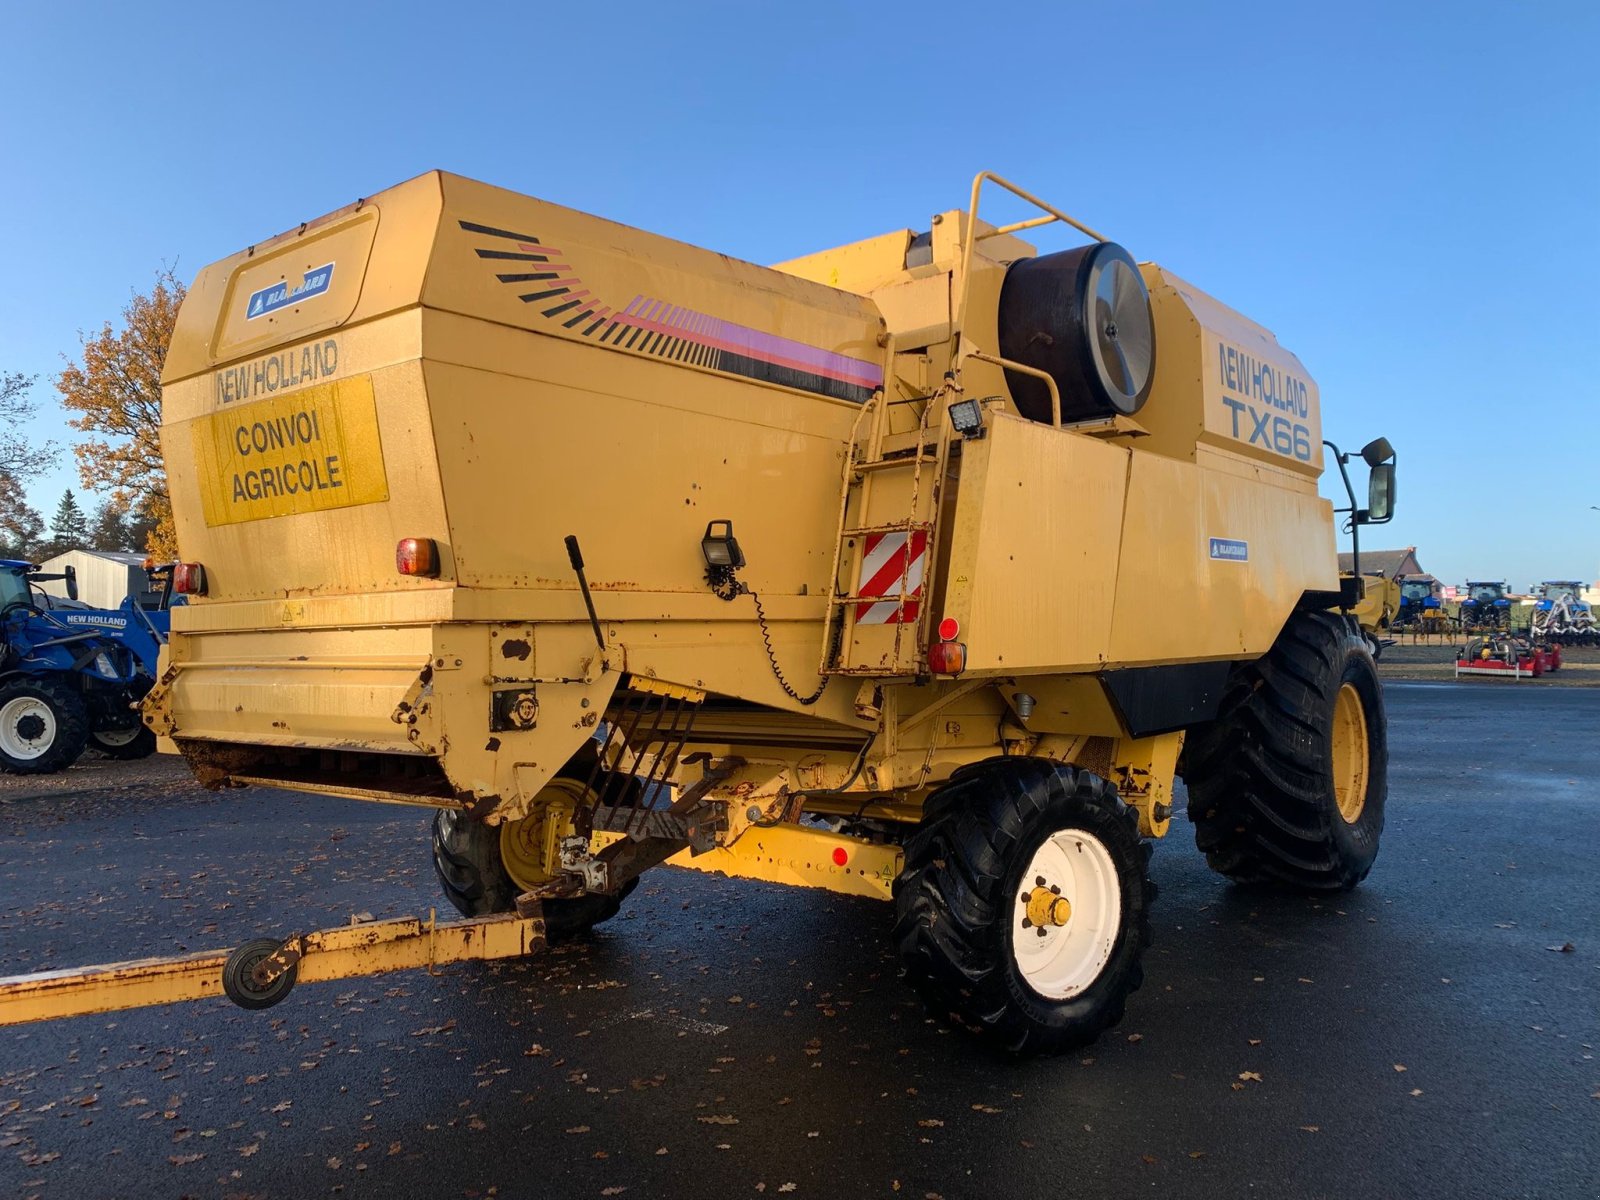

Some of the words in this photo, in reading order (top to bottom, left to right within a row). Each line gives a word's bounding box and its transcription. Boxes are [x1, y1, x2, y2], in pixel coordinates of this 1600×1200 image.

[216, 364, 251, 405] NEW
[254, 339, 338, 396] HOLLAND
[1219, 342, 1250, 396] NEW
[1252, 358, 1308, 419] HOLLAND
[236, 410, 320, 456] CONVOI
[1222, 395, 1311, 461] TX66
[233, 456, 342, 503] AGRICOLE
[67, 615, 87, 623] NEW
[87, 615, 127, 626] HOLLAND
